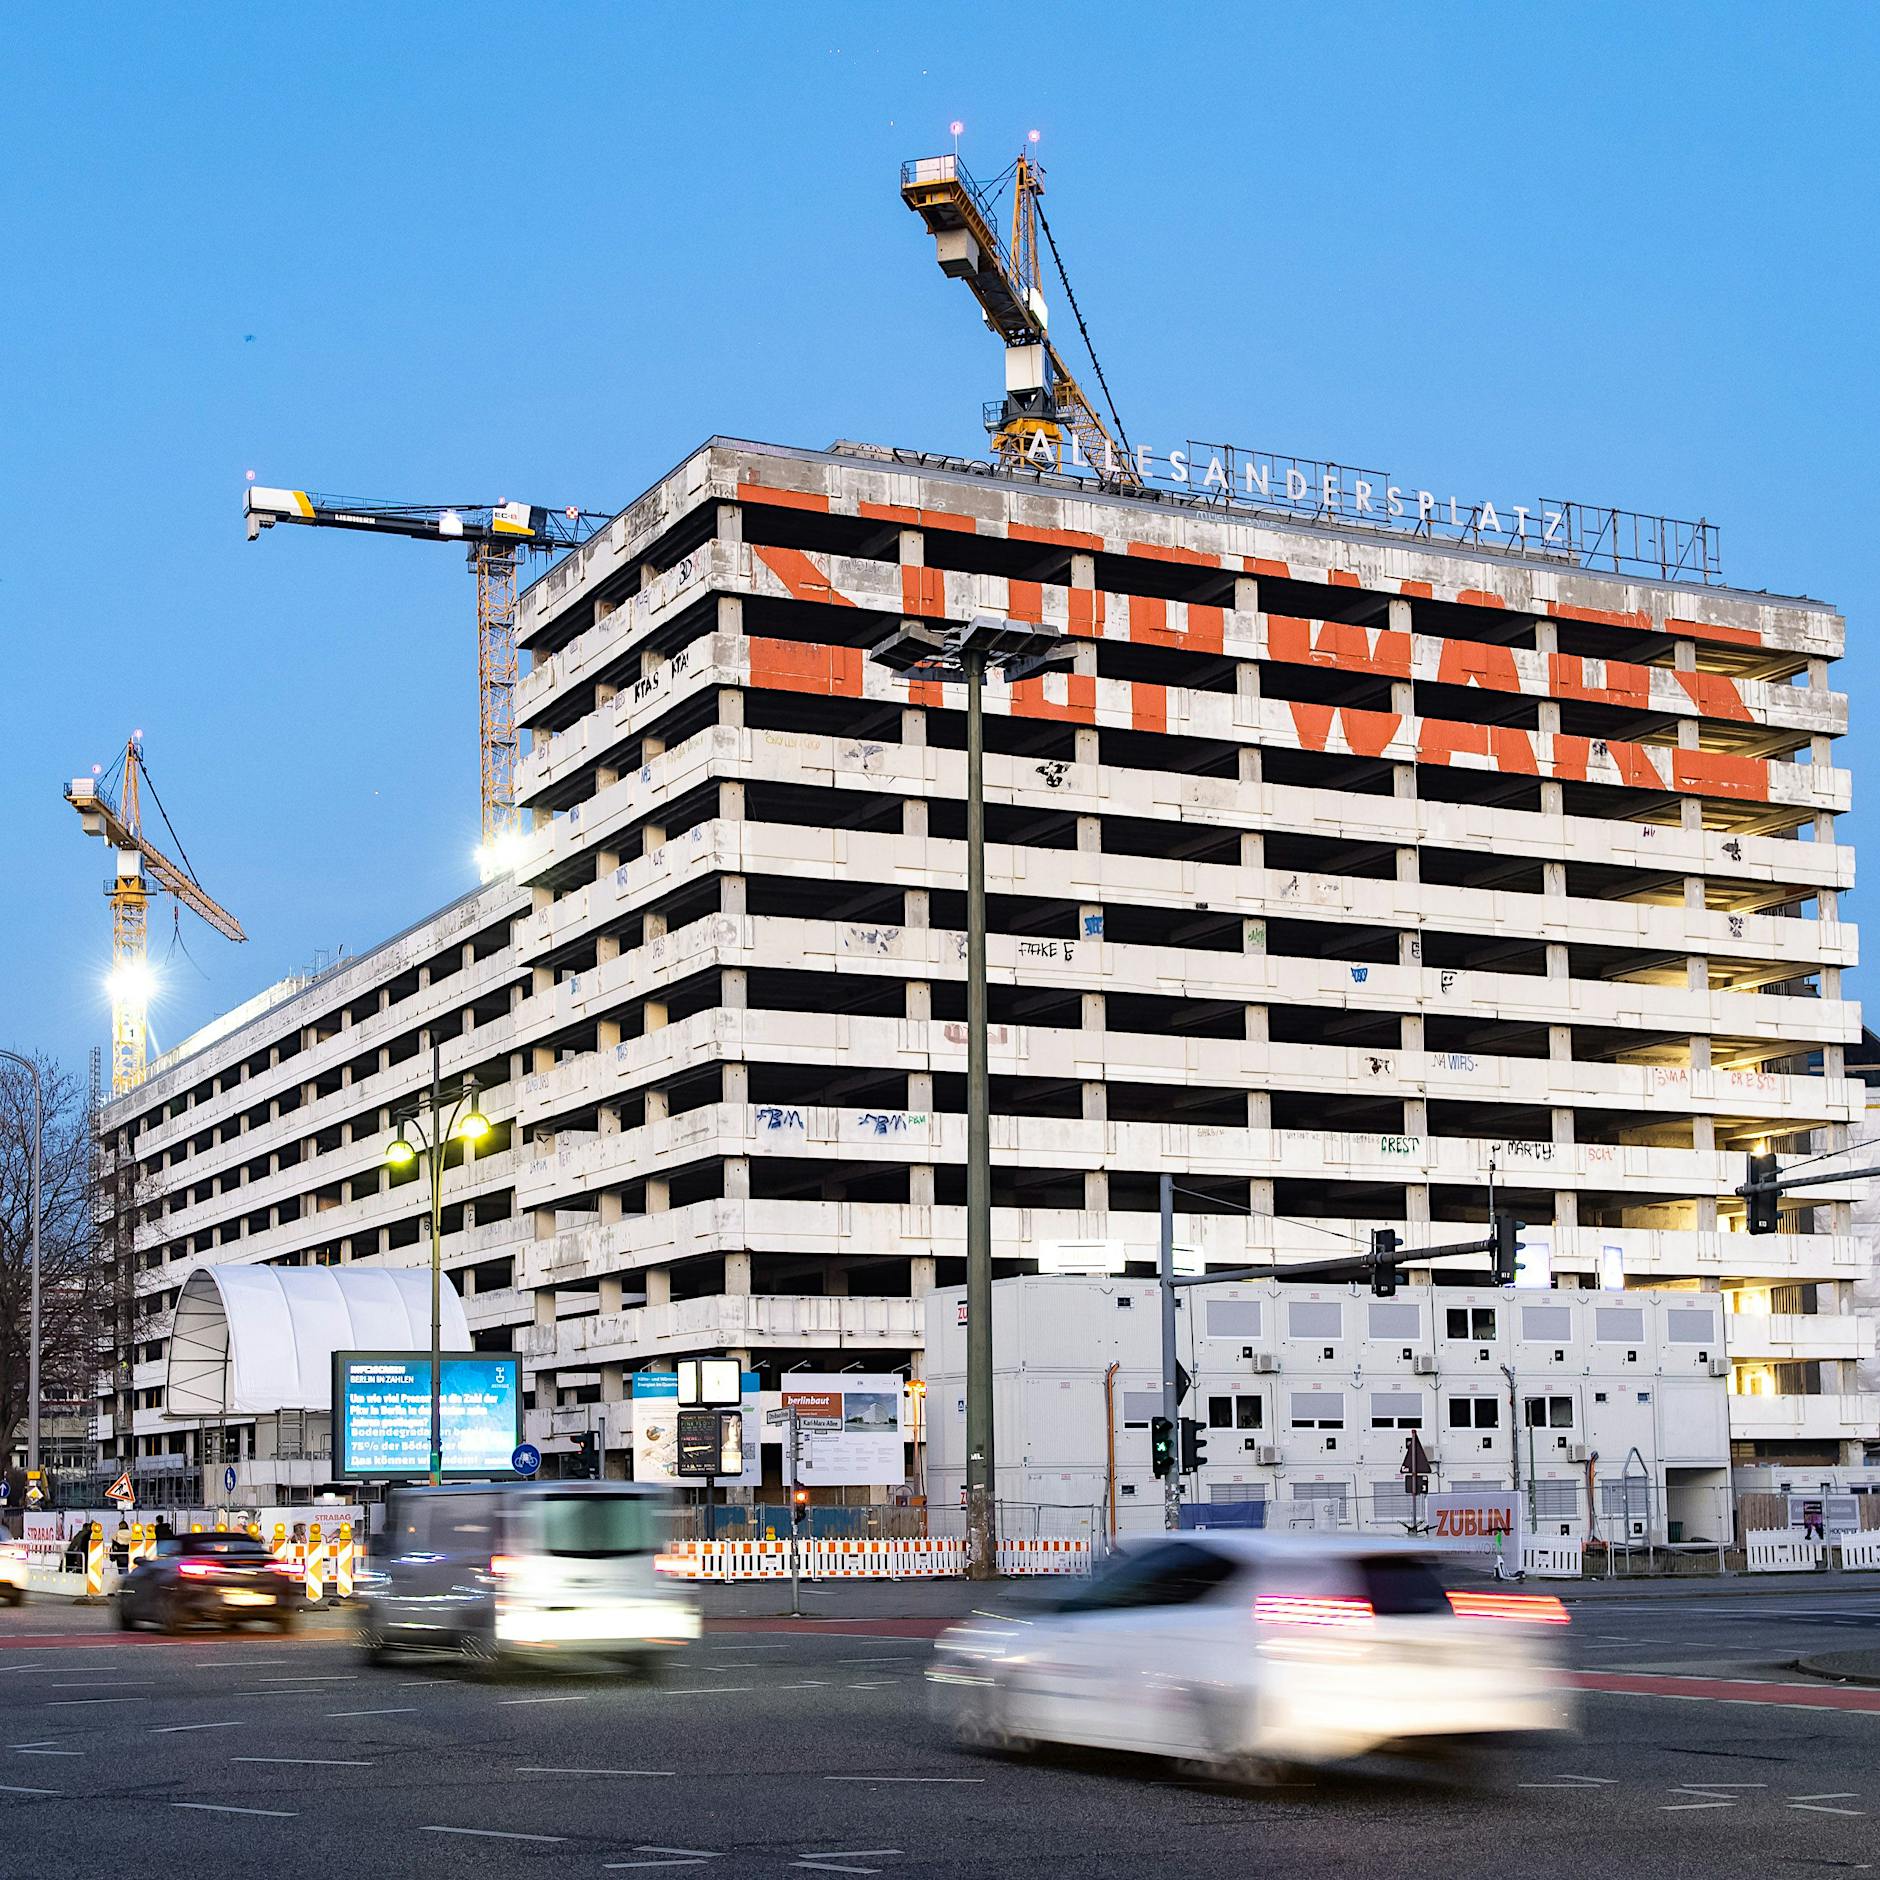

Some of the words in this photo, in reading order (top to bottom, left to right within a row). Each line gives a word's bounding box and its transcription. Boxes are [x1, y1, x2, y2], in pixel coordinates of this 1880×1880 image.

[1026, 427, 1564, 543] ALLESANDERSPLATZ
[385, 1375, 414, 1384] ZAHLEN
[787, 1395, 830, 1405] berlinbaut
[803, 1419, 838, 1427] Karl-Marx-Allee
[381, 1441, 400, 1451] der
[314, 1513, 352, 1522] STRABAG
